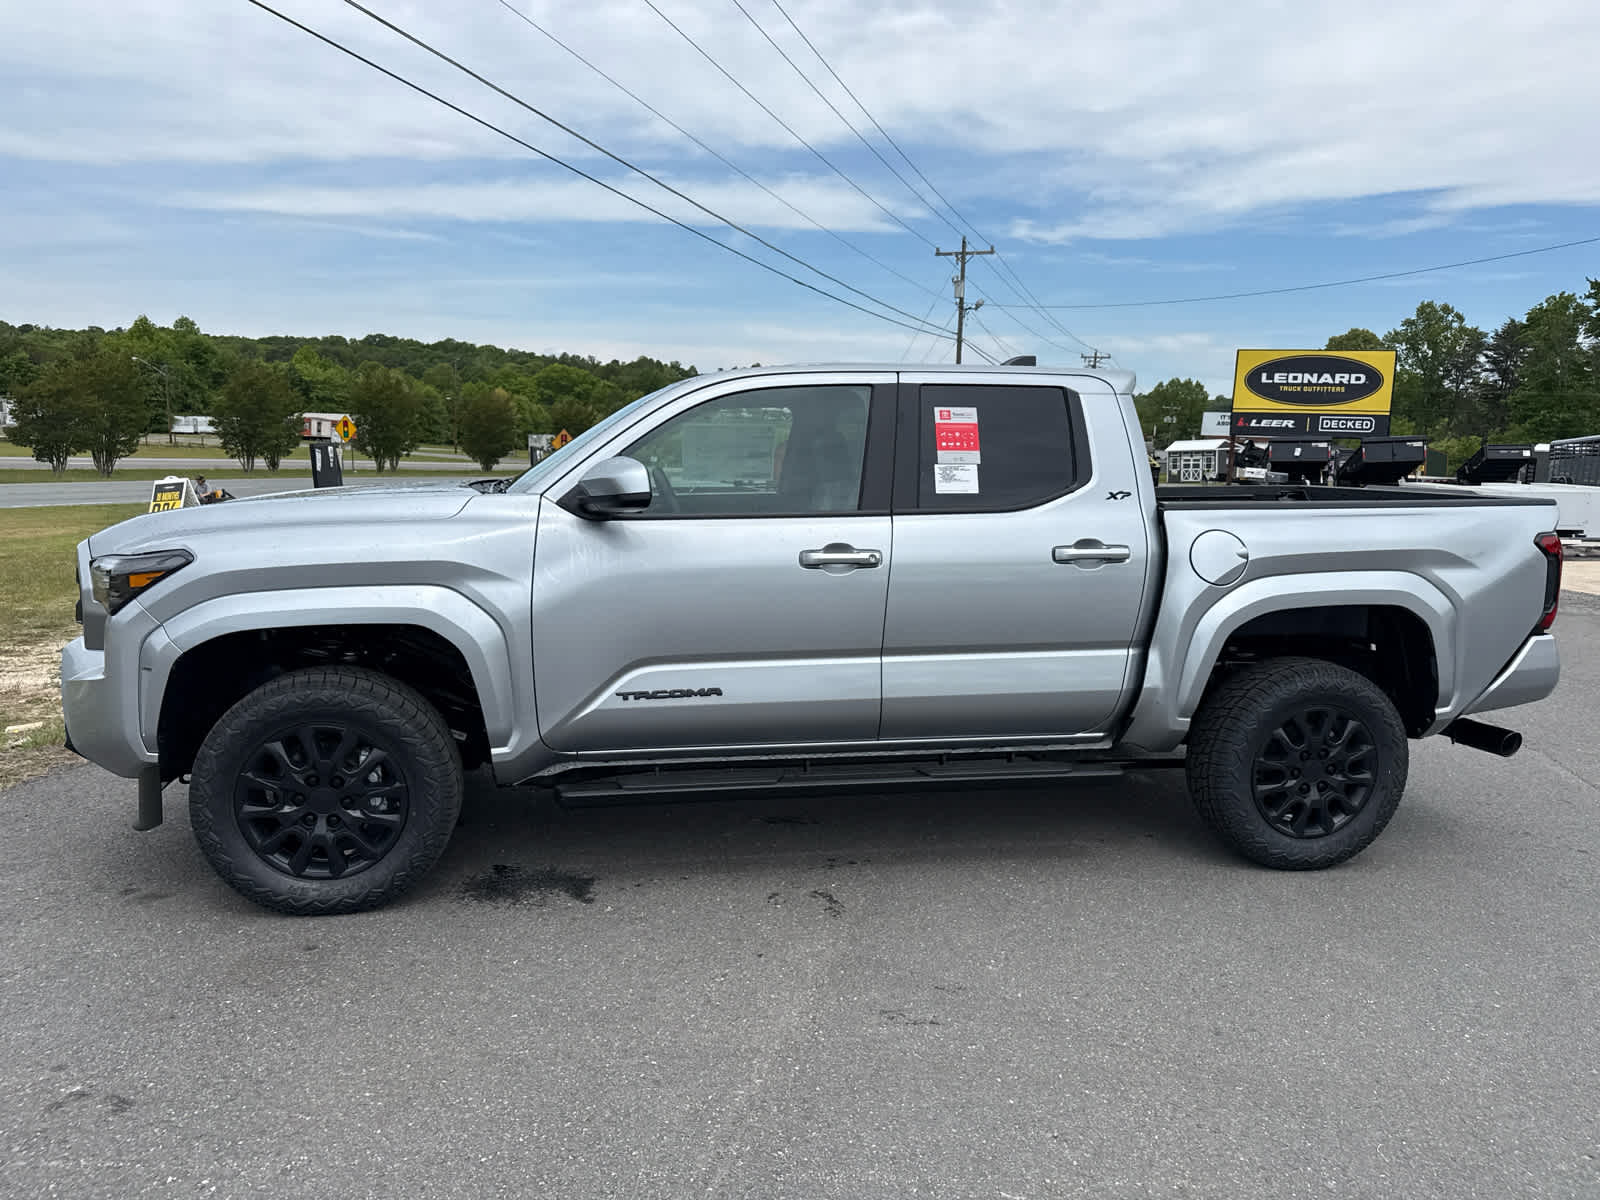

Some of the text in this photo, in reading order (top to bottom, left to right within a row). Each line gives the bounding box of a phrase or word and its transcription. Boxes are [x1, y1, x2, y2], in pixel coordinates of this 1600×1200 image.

[1261, 373, 1366, 384] LEONARD
[1303, 385, 1345, 393] OUTFITTERS
[1250, 419, 1371, 429] LEER DECKED
[615, 687, 723, 701] TACOMA
